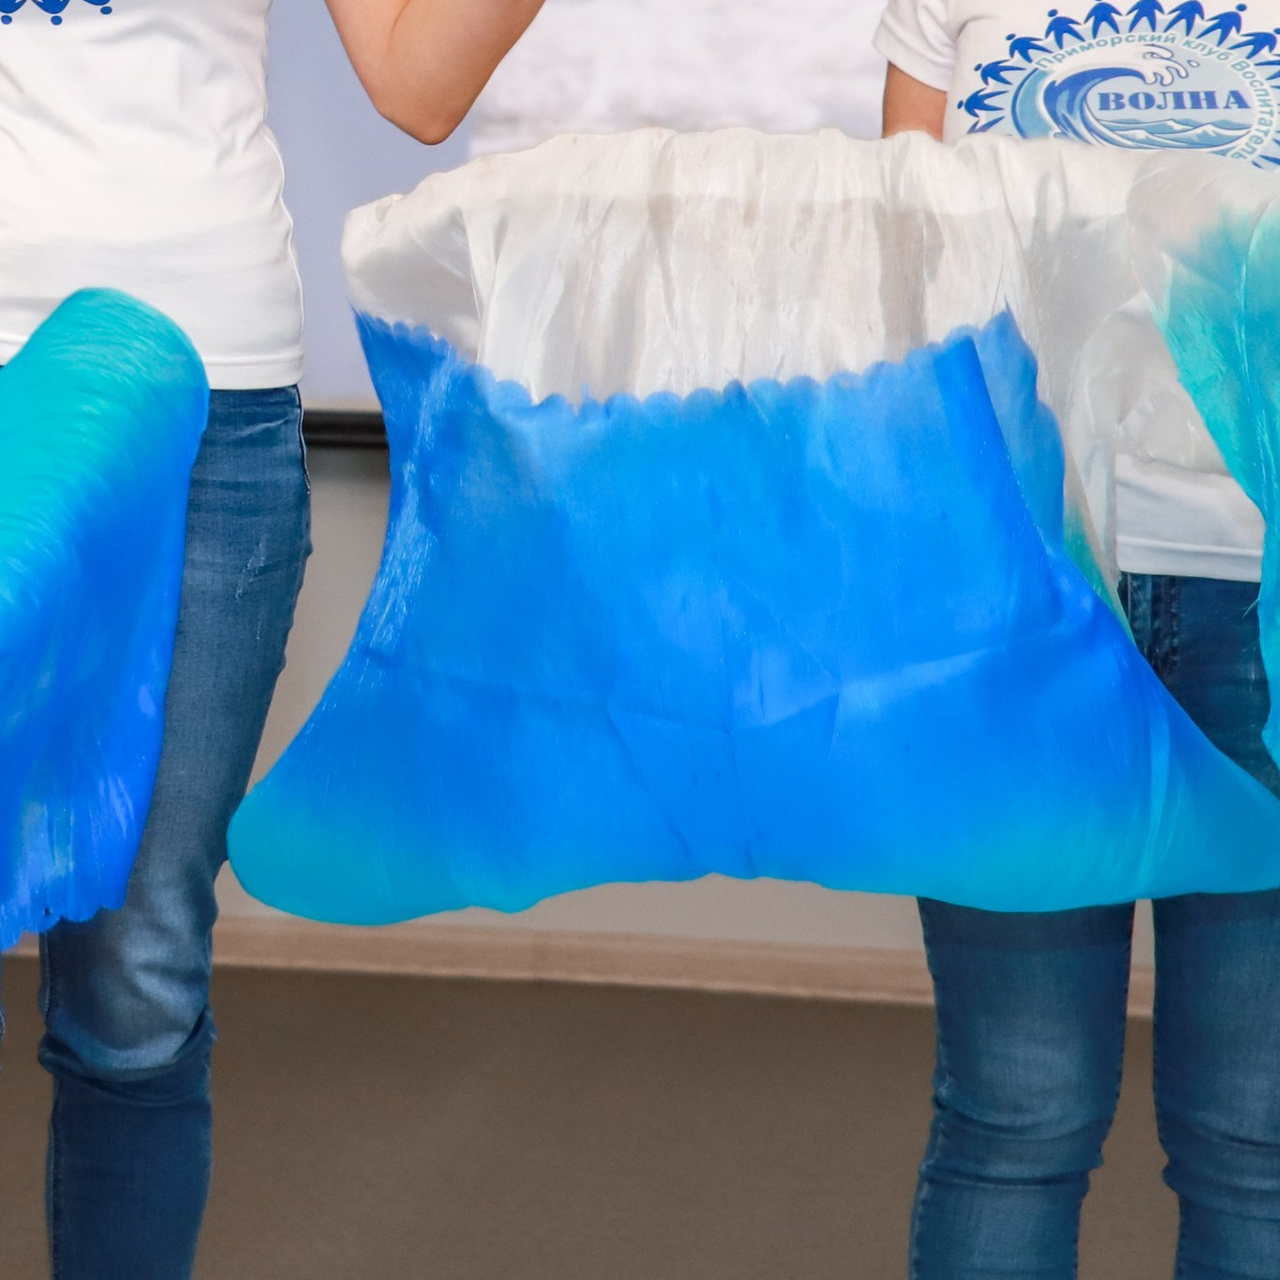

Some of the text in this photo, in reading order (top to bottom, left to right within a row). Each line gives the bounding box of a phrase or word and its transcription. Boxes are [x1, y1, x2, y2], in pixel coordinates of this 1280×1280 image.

[1034, 32, 1275, 160] Приморский клуб Воспитатель
[1097, 90, 1252, 111] ВОЛНА
